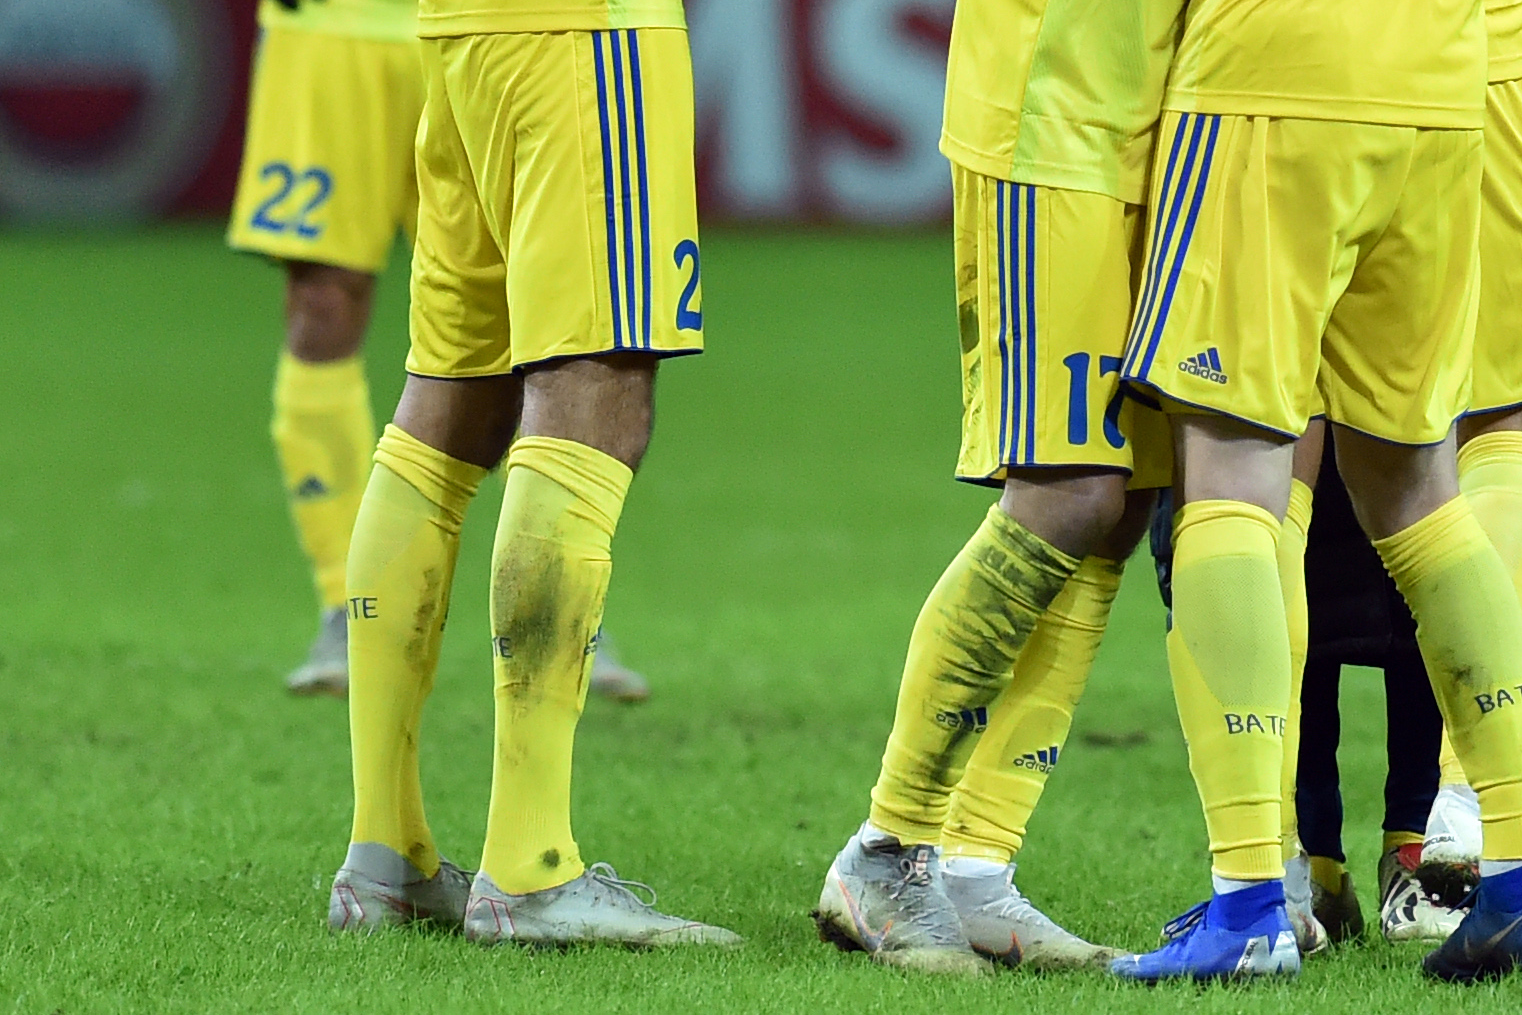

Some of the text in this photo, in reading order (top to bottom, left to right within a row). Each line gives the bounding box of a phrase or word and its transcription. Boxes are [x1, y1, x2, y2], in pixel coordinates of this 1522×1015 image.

[251, 160, 333, 239] 22
[1178, 361, 1228, 384] adidas
[1224, 713, 1287, 737] BATE
